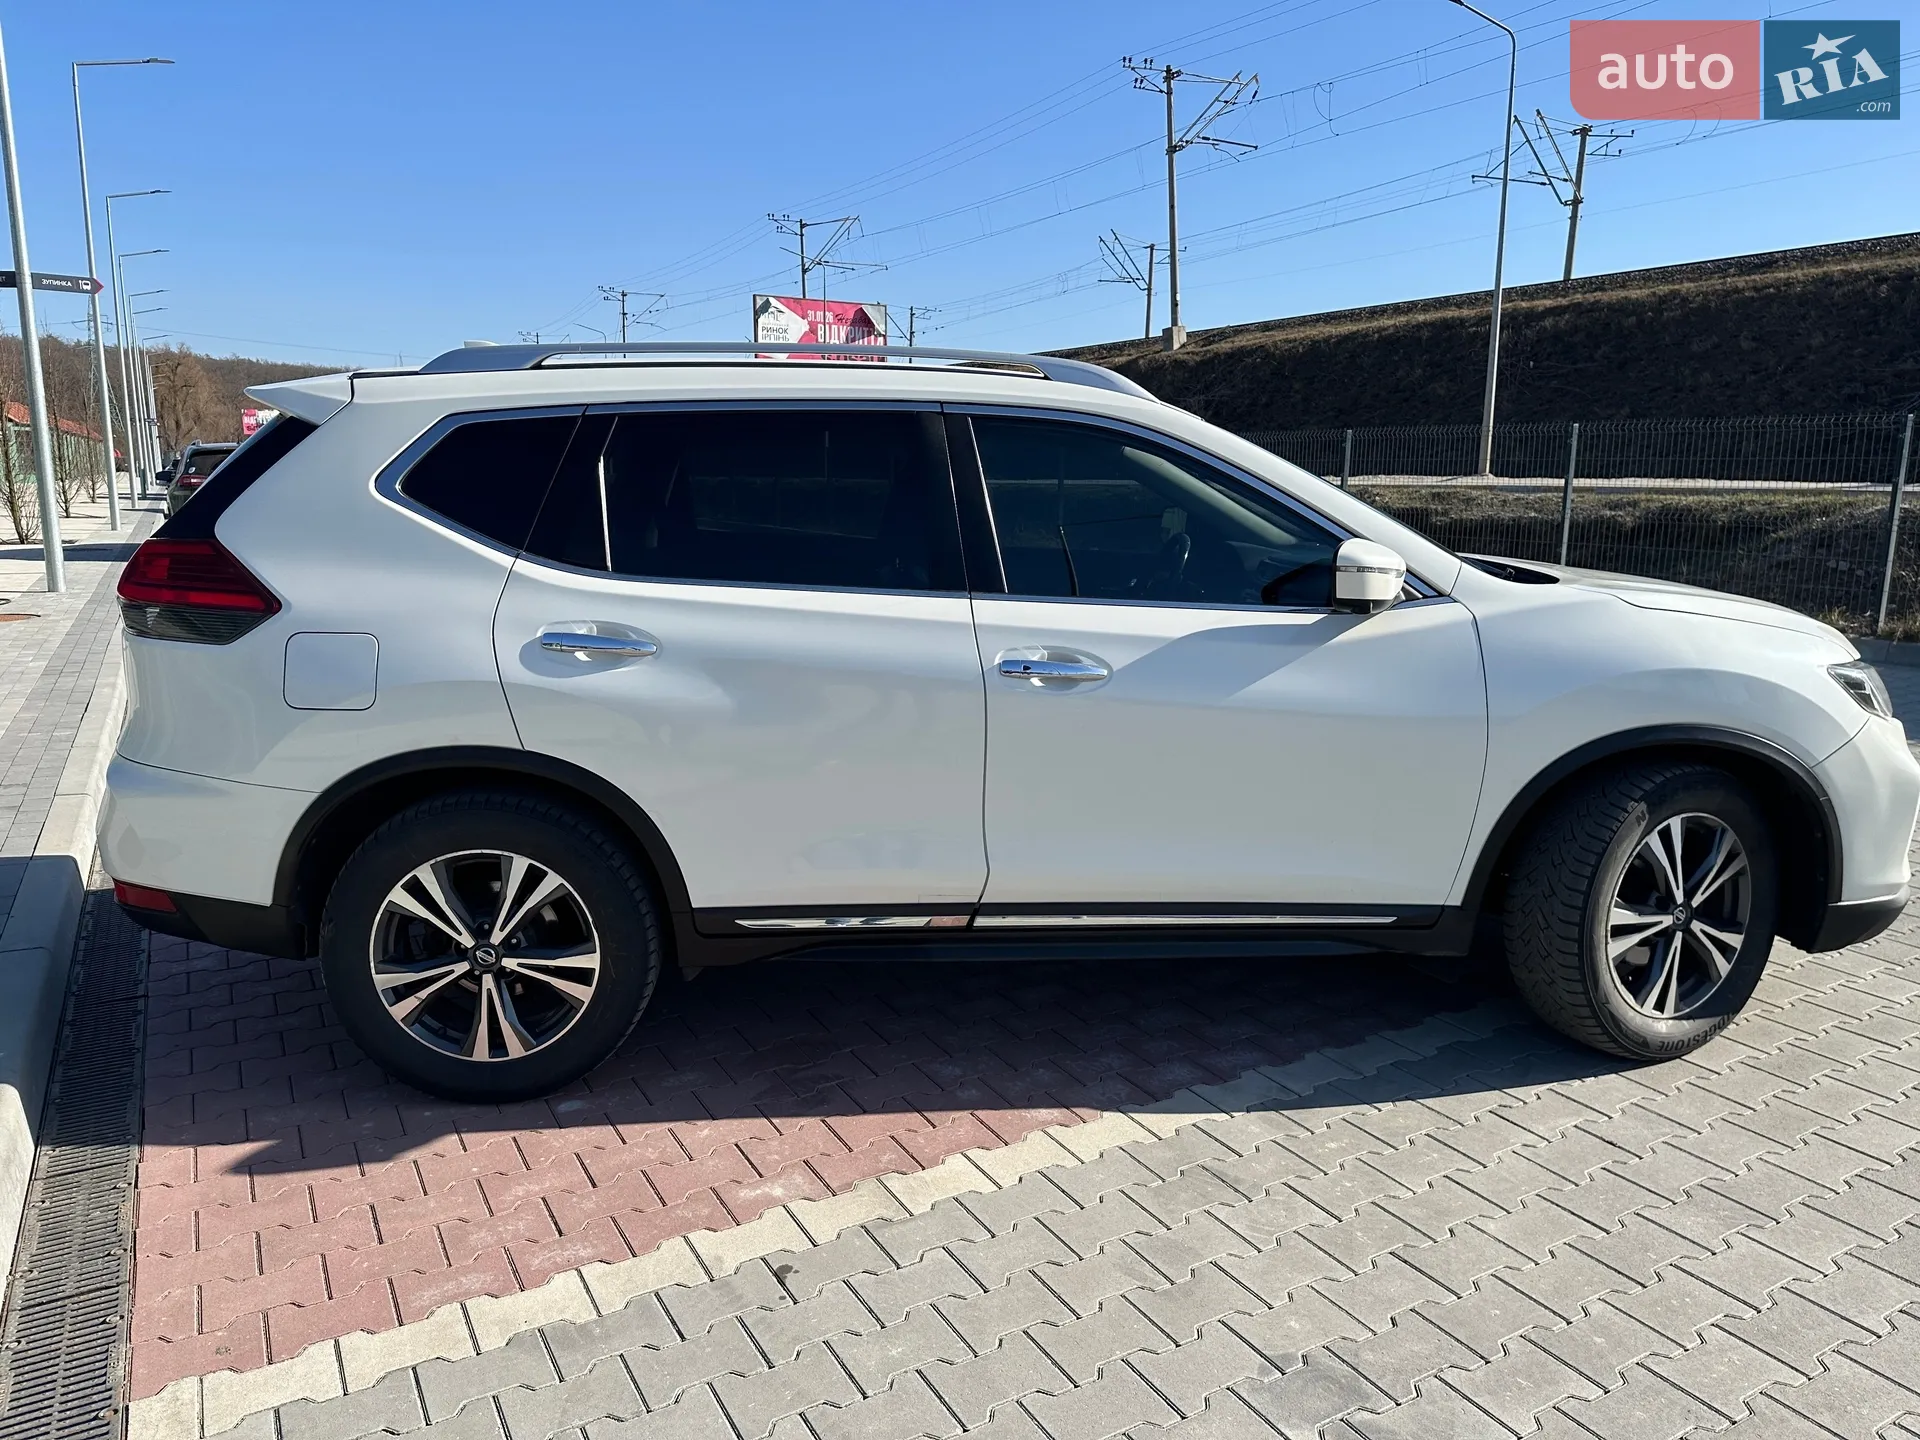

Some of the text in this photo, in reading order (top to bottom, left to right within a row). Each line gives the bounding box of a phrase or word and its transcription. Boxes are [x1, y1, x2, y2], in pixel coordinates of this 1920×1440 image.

[41, 278, 72, 287] ЗУПИНКА
[807, 309, 834, 323] 31.0126
[761, 326, 789, 335] РИНОК
[761, 333, 790, 342] ІРПІНЬ
[1655, 1013, 1733, 1053] IDGESTONE
